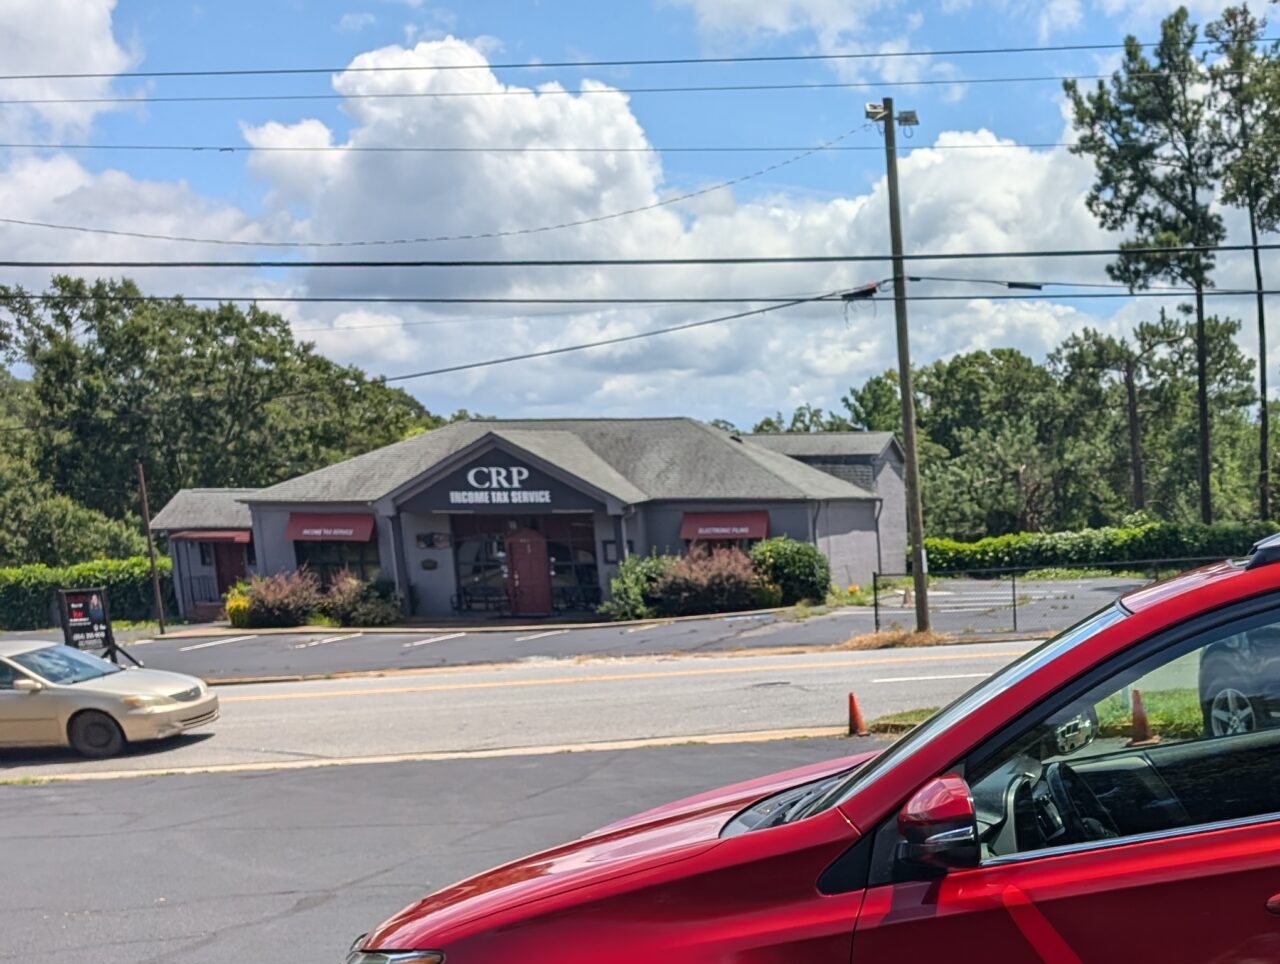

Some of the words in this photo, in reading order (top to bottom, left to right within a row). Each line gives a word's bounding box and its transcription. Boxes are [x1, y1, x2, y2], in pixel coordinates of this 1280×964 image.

[466, 466, 530, 489] CRP
[449, 490, 490, 504] INCOME
[491, 490, 510, 504] TAX
[510, 490, 552, 504] SERVICE
